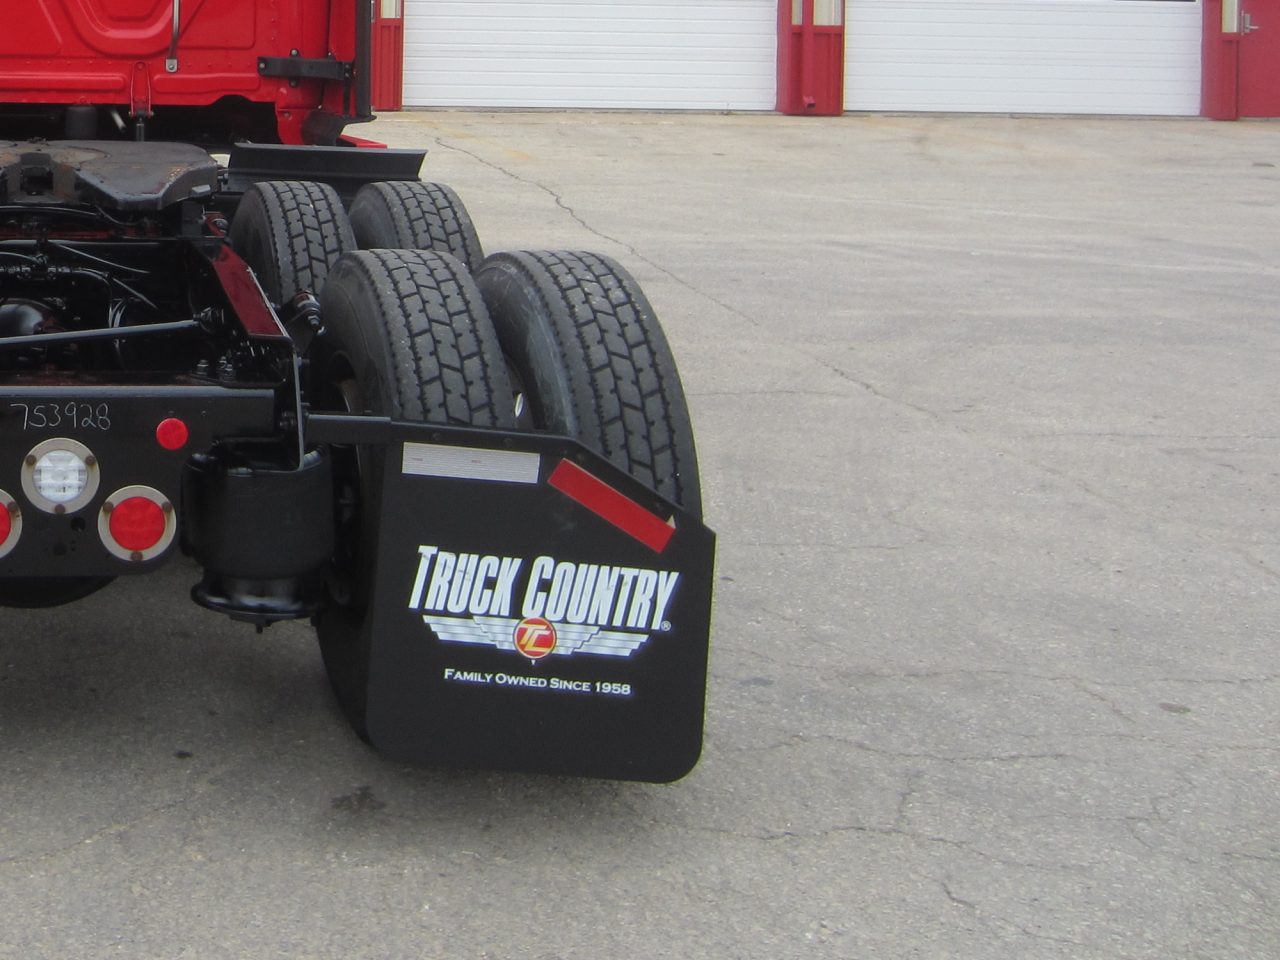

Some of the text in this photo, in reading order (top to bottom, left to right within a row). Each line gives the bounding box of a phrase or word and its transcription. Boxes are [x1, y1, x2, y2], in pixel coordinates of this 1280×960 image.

[10, 401, 111, 430] 753928
[408, 545, 522, 617] TRUCK
[444, 668, 631, 695] FAMILY OWNED SINCE 1958
